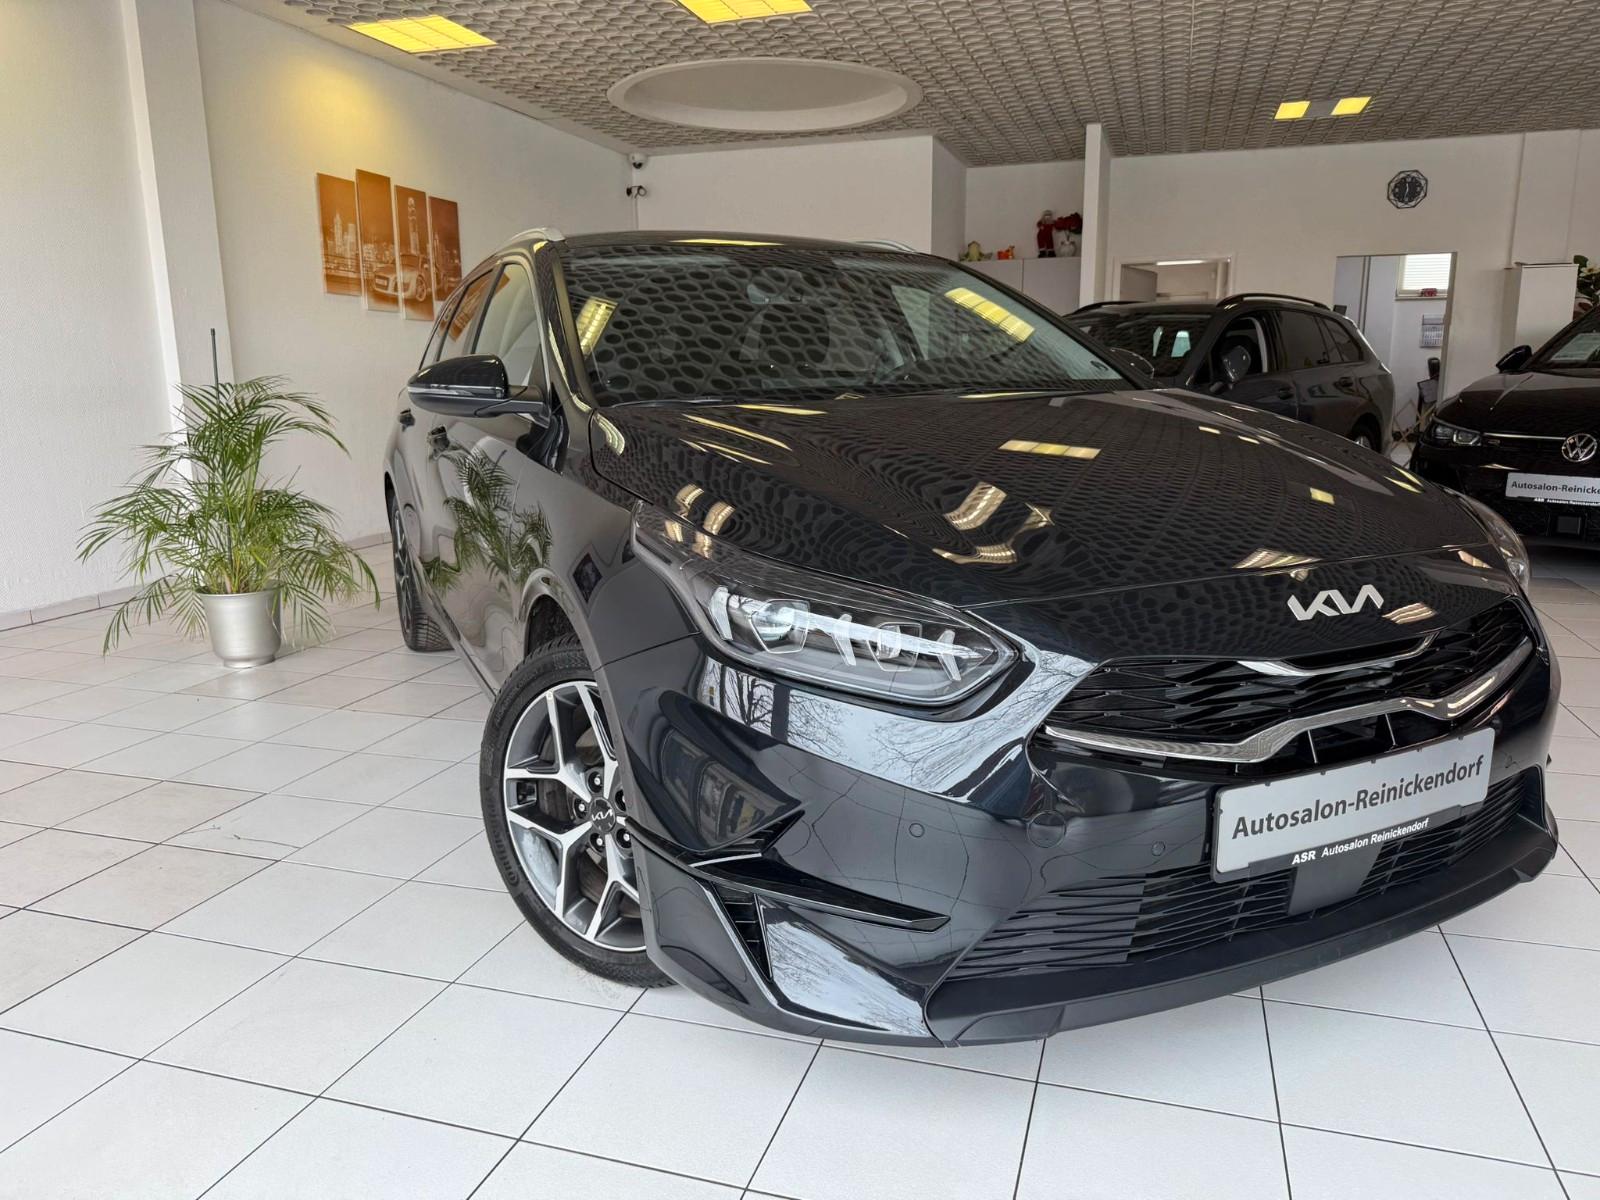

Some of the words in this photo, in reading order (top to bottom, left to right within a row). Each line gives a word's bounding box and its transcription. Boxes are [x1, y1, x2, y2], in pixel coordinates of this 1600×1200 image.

[1287, 584, 1384, 620] KIA
[1232, 755, 1484, 840] Autosalon-Reinickendorf
[1291, 850, 1317, 865] ASR
[1321, 838, 1369, 858] Autosalon
[1370, 817, 1430, 845] Reinickendorf
